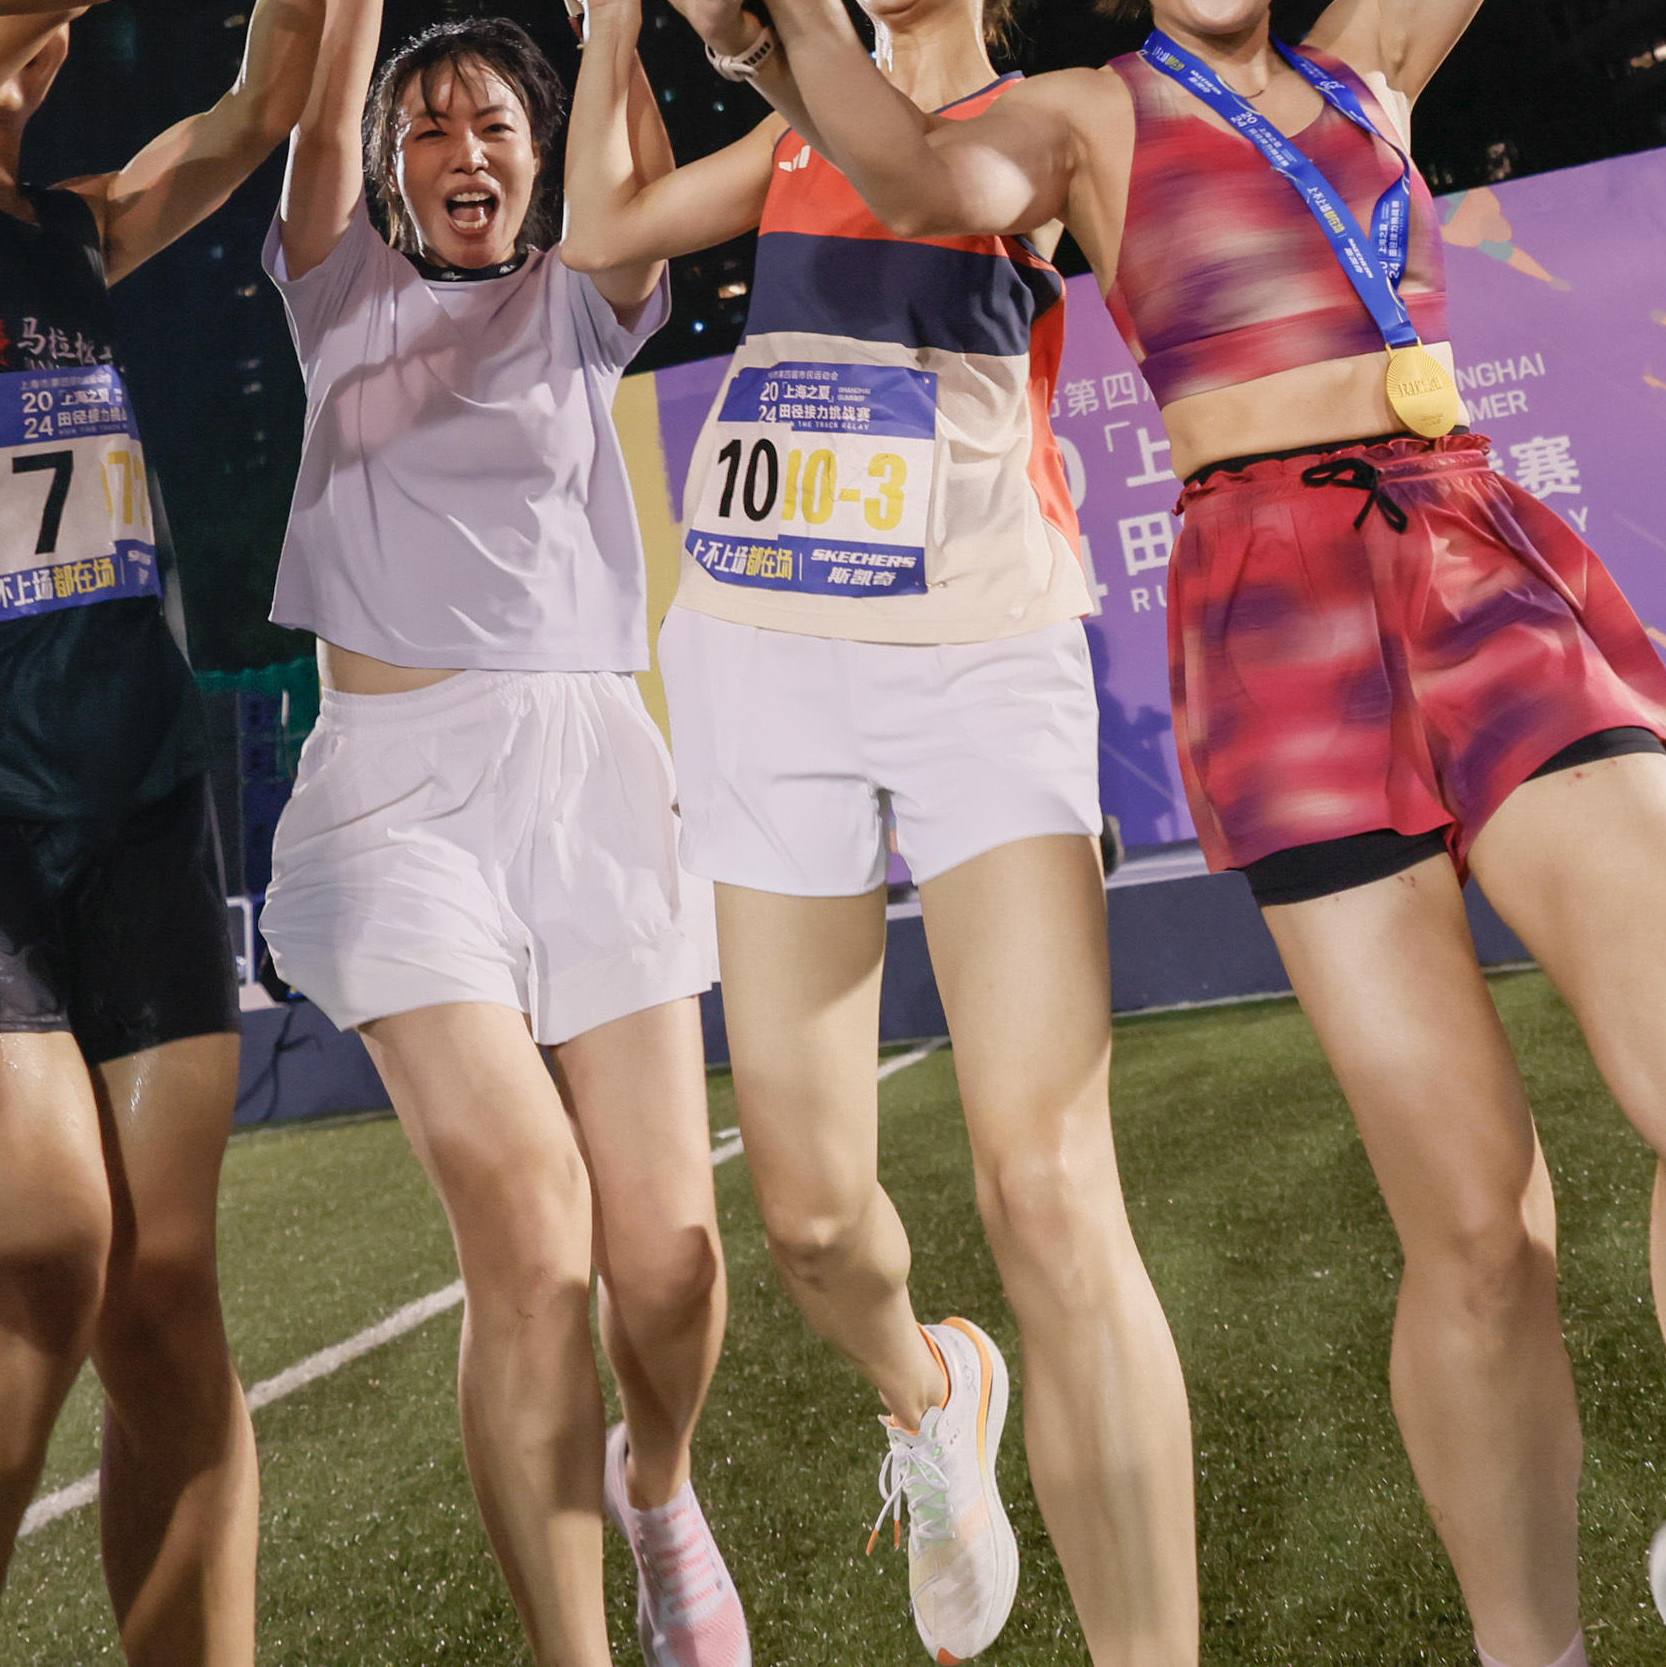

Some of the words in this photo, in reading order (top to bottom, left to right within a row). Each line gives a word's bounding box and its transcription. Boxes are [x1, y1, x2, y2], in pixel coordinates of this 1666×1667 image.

[21, 390, 54, 414] 20
[759, 381, 780, 402] 20
[758, 404, 777, 423] 24
[779, 403, 871, 422] 田径接力挑战赛
[23, 415, 54, 439] 24
[717, 438, 779, 522] 10
[781, 448, 908, 532] 10-3
[12, 449, 74, 555] 7
[810, 547, 917, 569] SKECHERS
[827, 566, 897, 587] 斯凯奇
